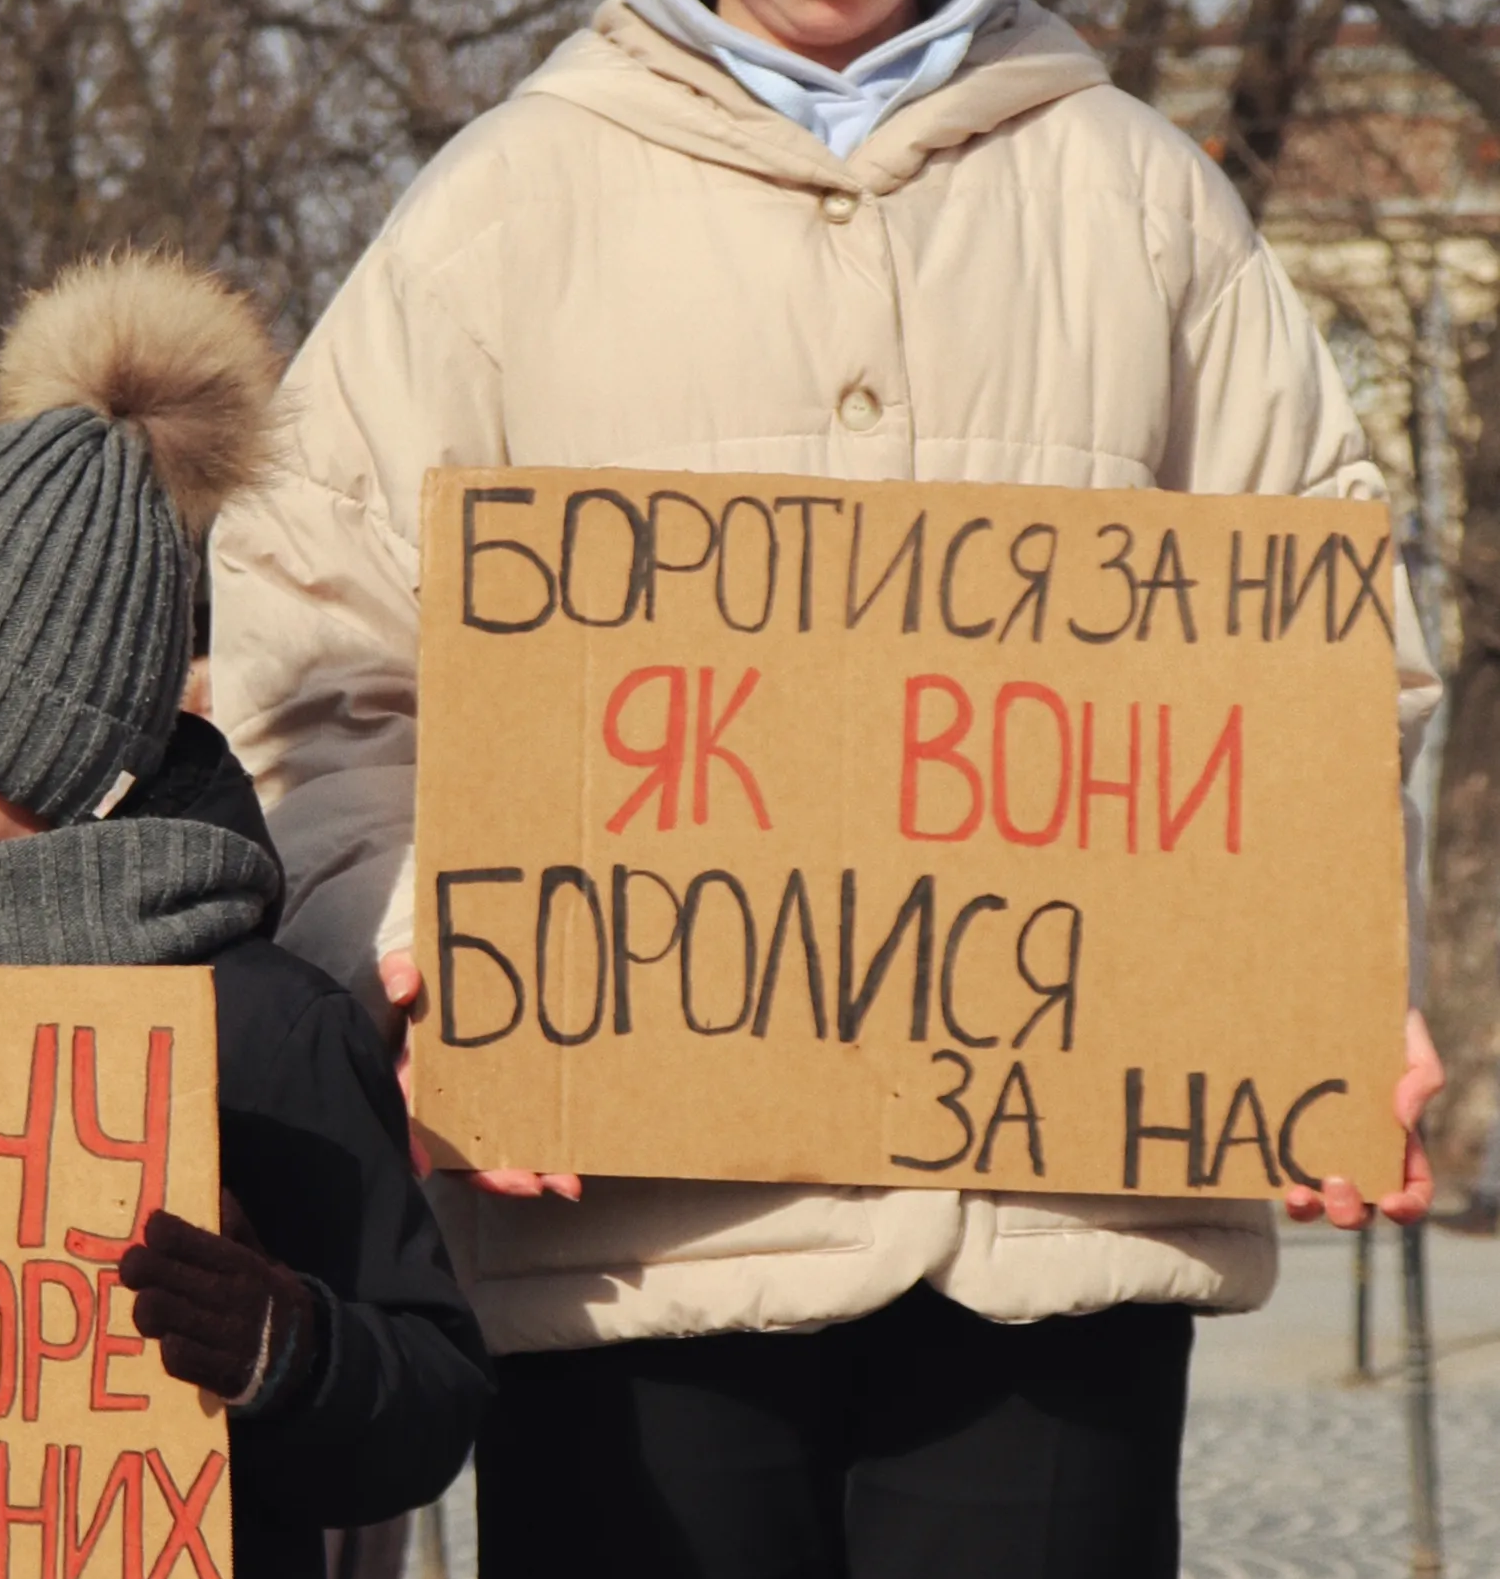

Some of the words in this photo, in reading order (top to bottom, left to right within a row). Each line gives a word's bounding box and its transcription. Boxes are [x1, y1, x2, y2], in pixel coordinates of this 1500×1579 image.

[460, 487, 1058, 644] БОРОТИСЯ
[1068, 523, 1199, 644] ЗА
[1226, 530, 1395, 644] НИХ
[602, 665, 774, 834] ЯК
[900, 674, 1243, 855] ВОНИ
[436, 864, 1083, 1051] БОРОЛИСЯ
[890, 1049, 1047, 1177] ЗА
[1122, 1068, 1348, 1191] НАС
